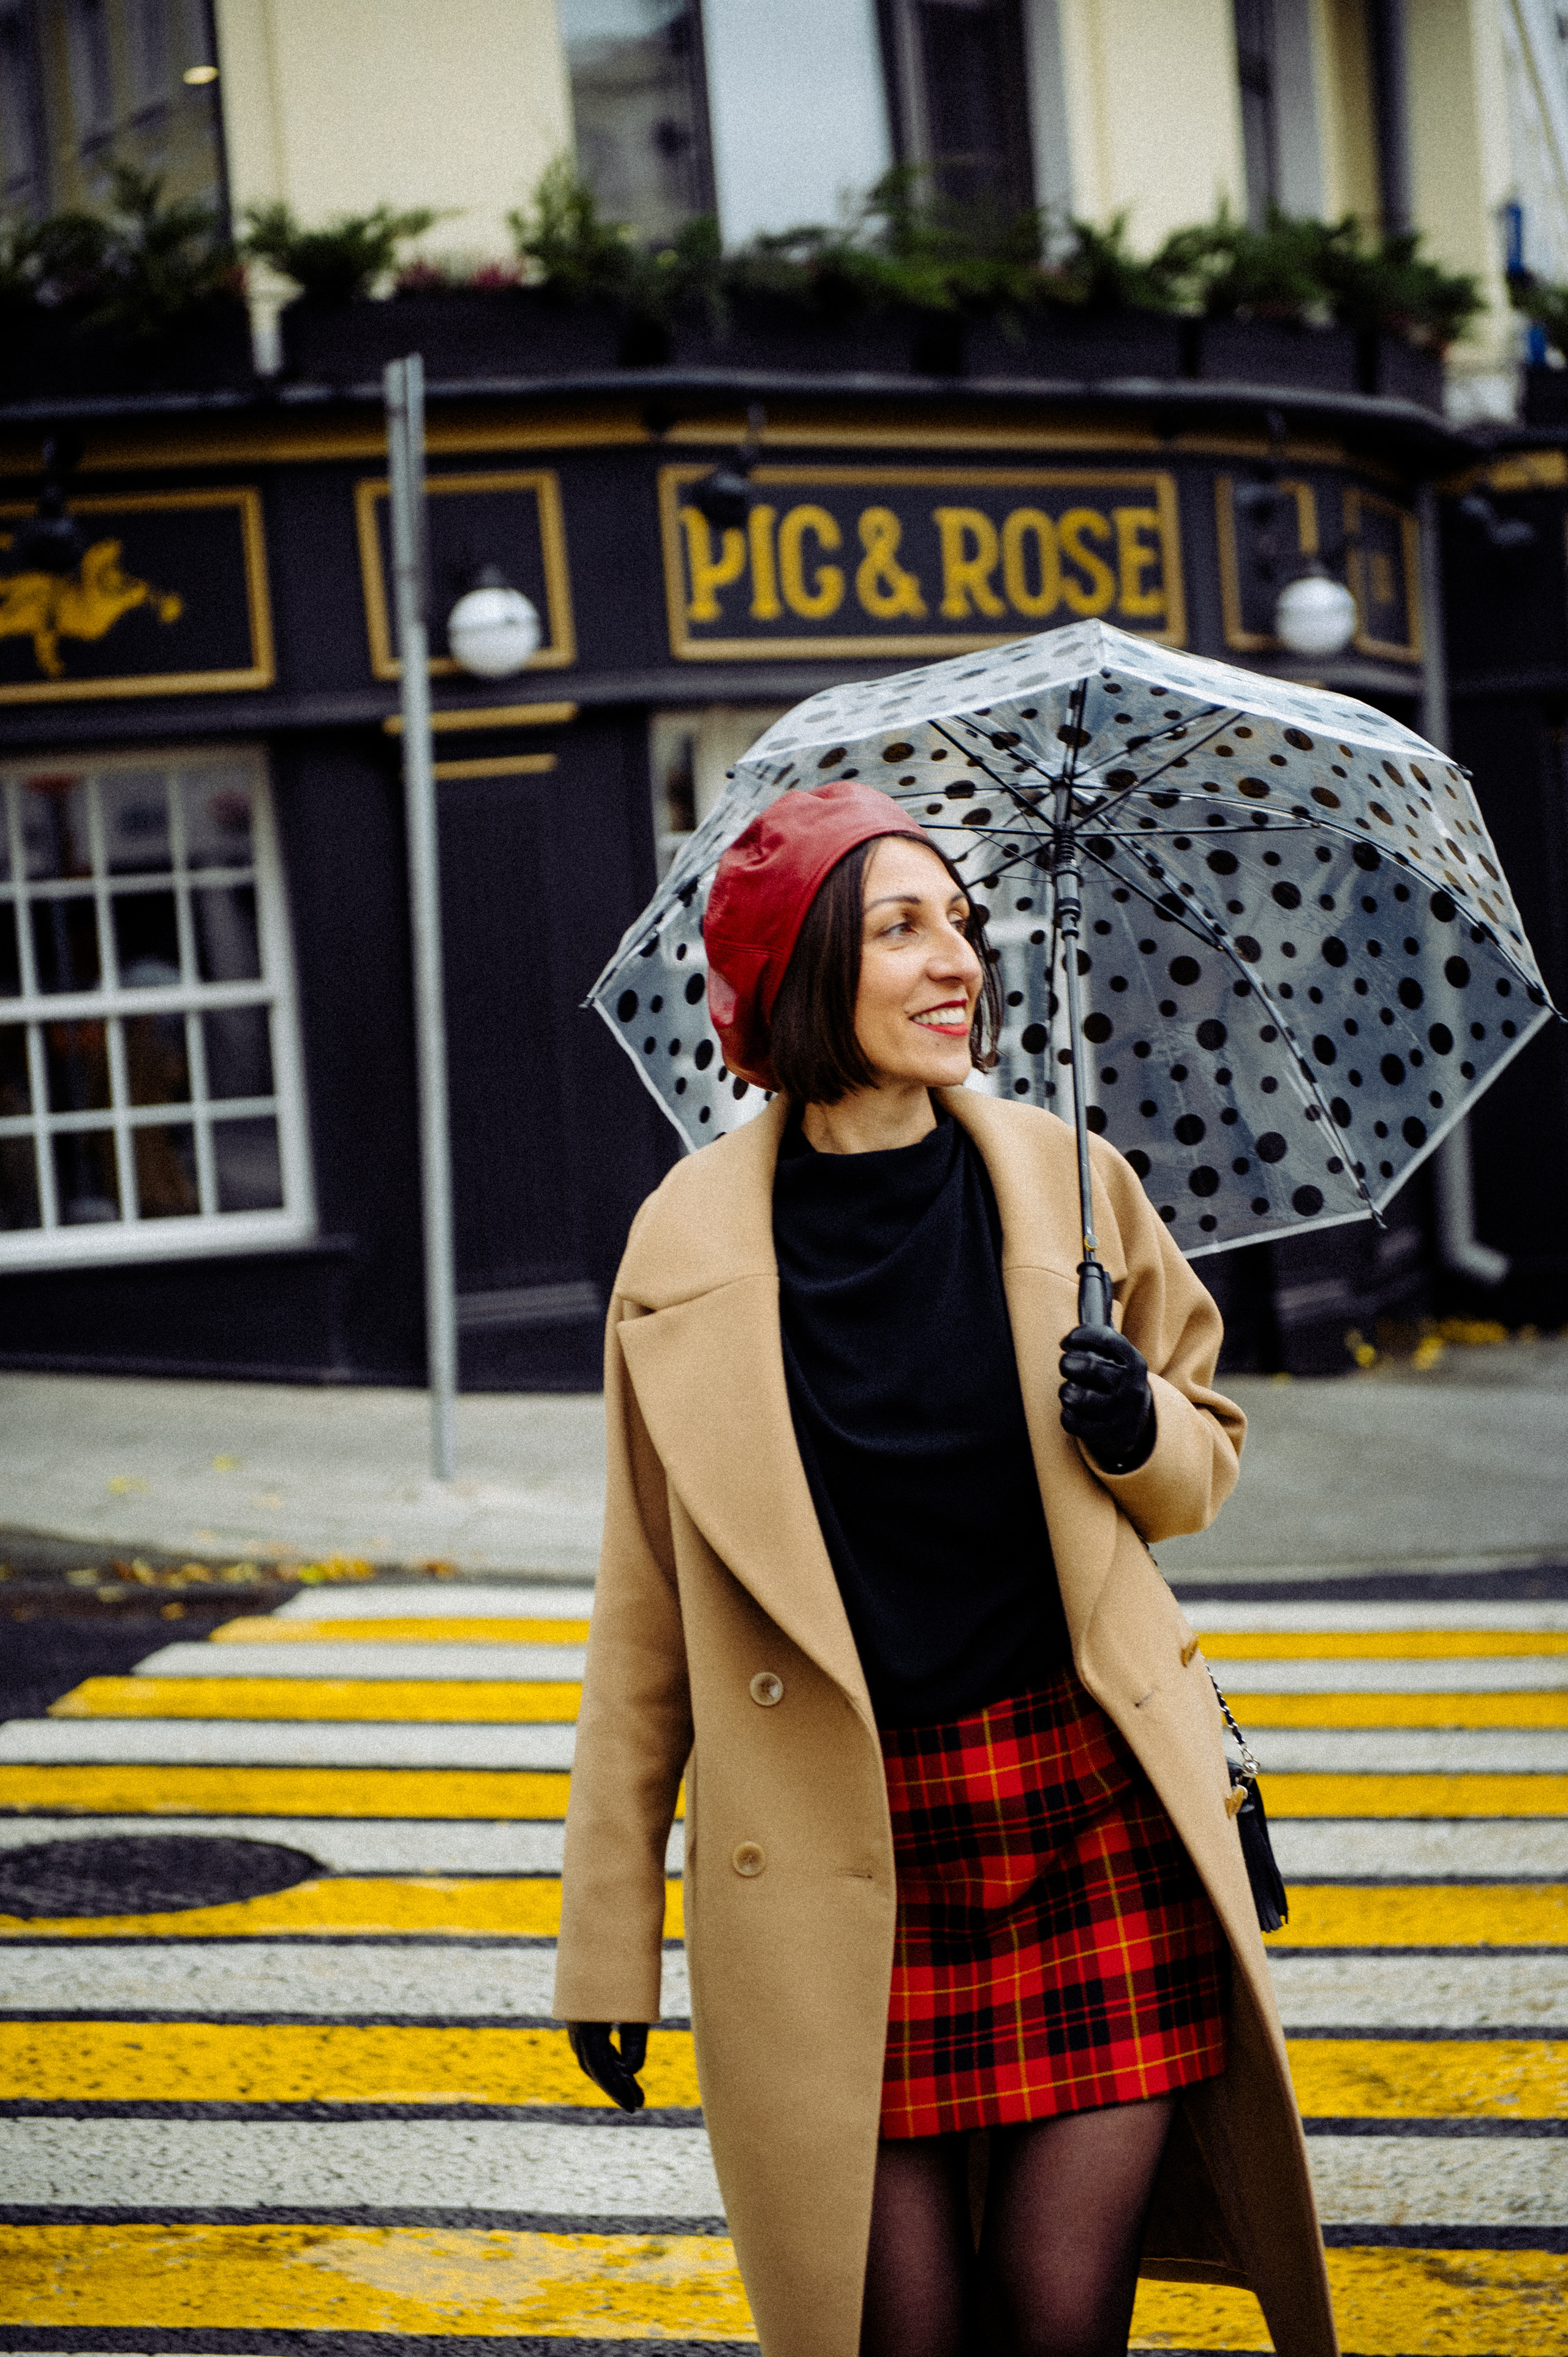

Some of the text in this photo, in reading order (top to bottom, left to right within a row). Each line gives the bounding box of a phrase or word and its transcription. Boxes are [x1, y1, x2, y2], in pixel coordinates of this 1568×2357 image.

[681, 504, 1164, 622] PIG & ROSE
